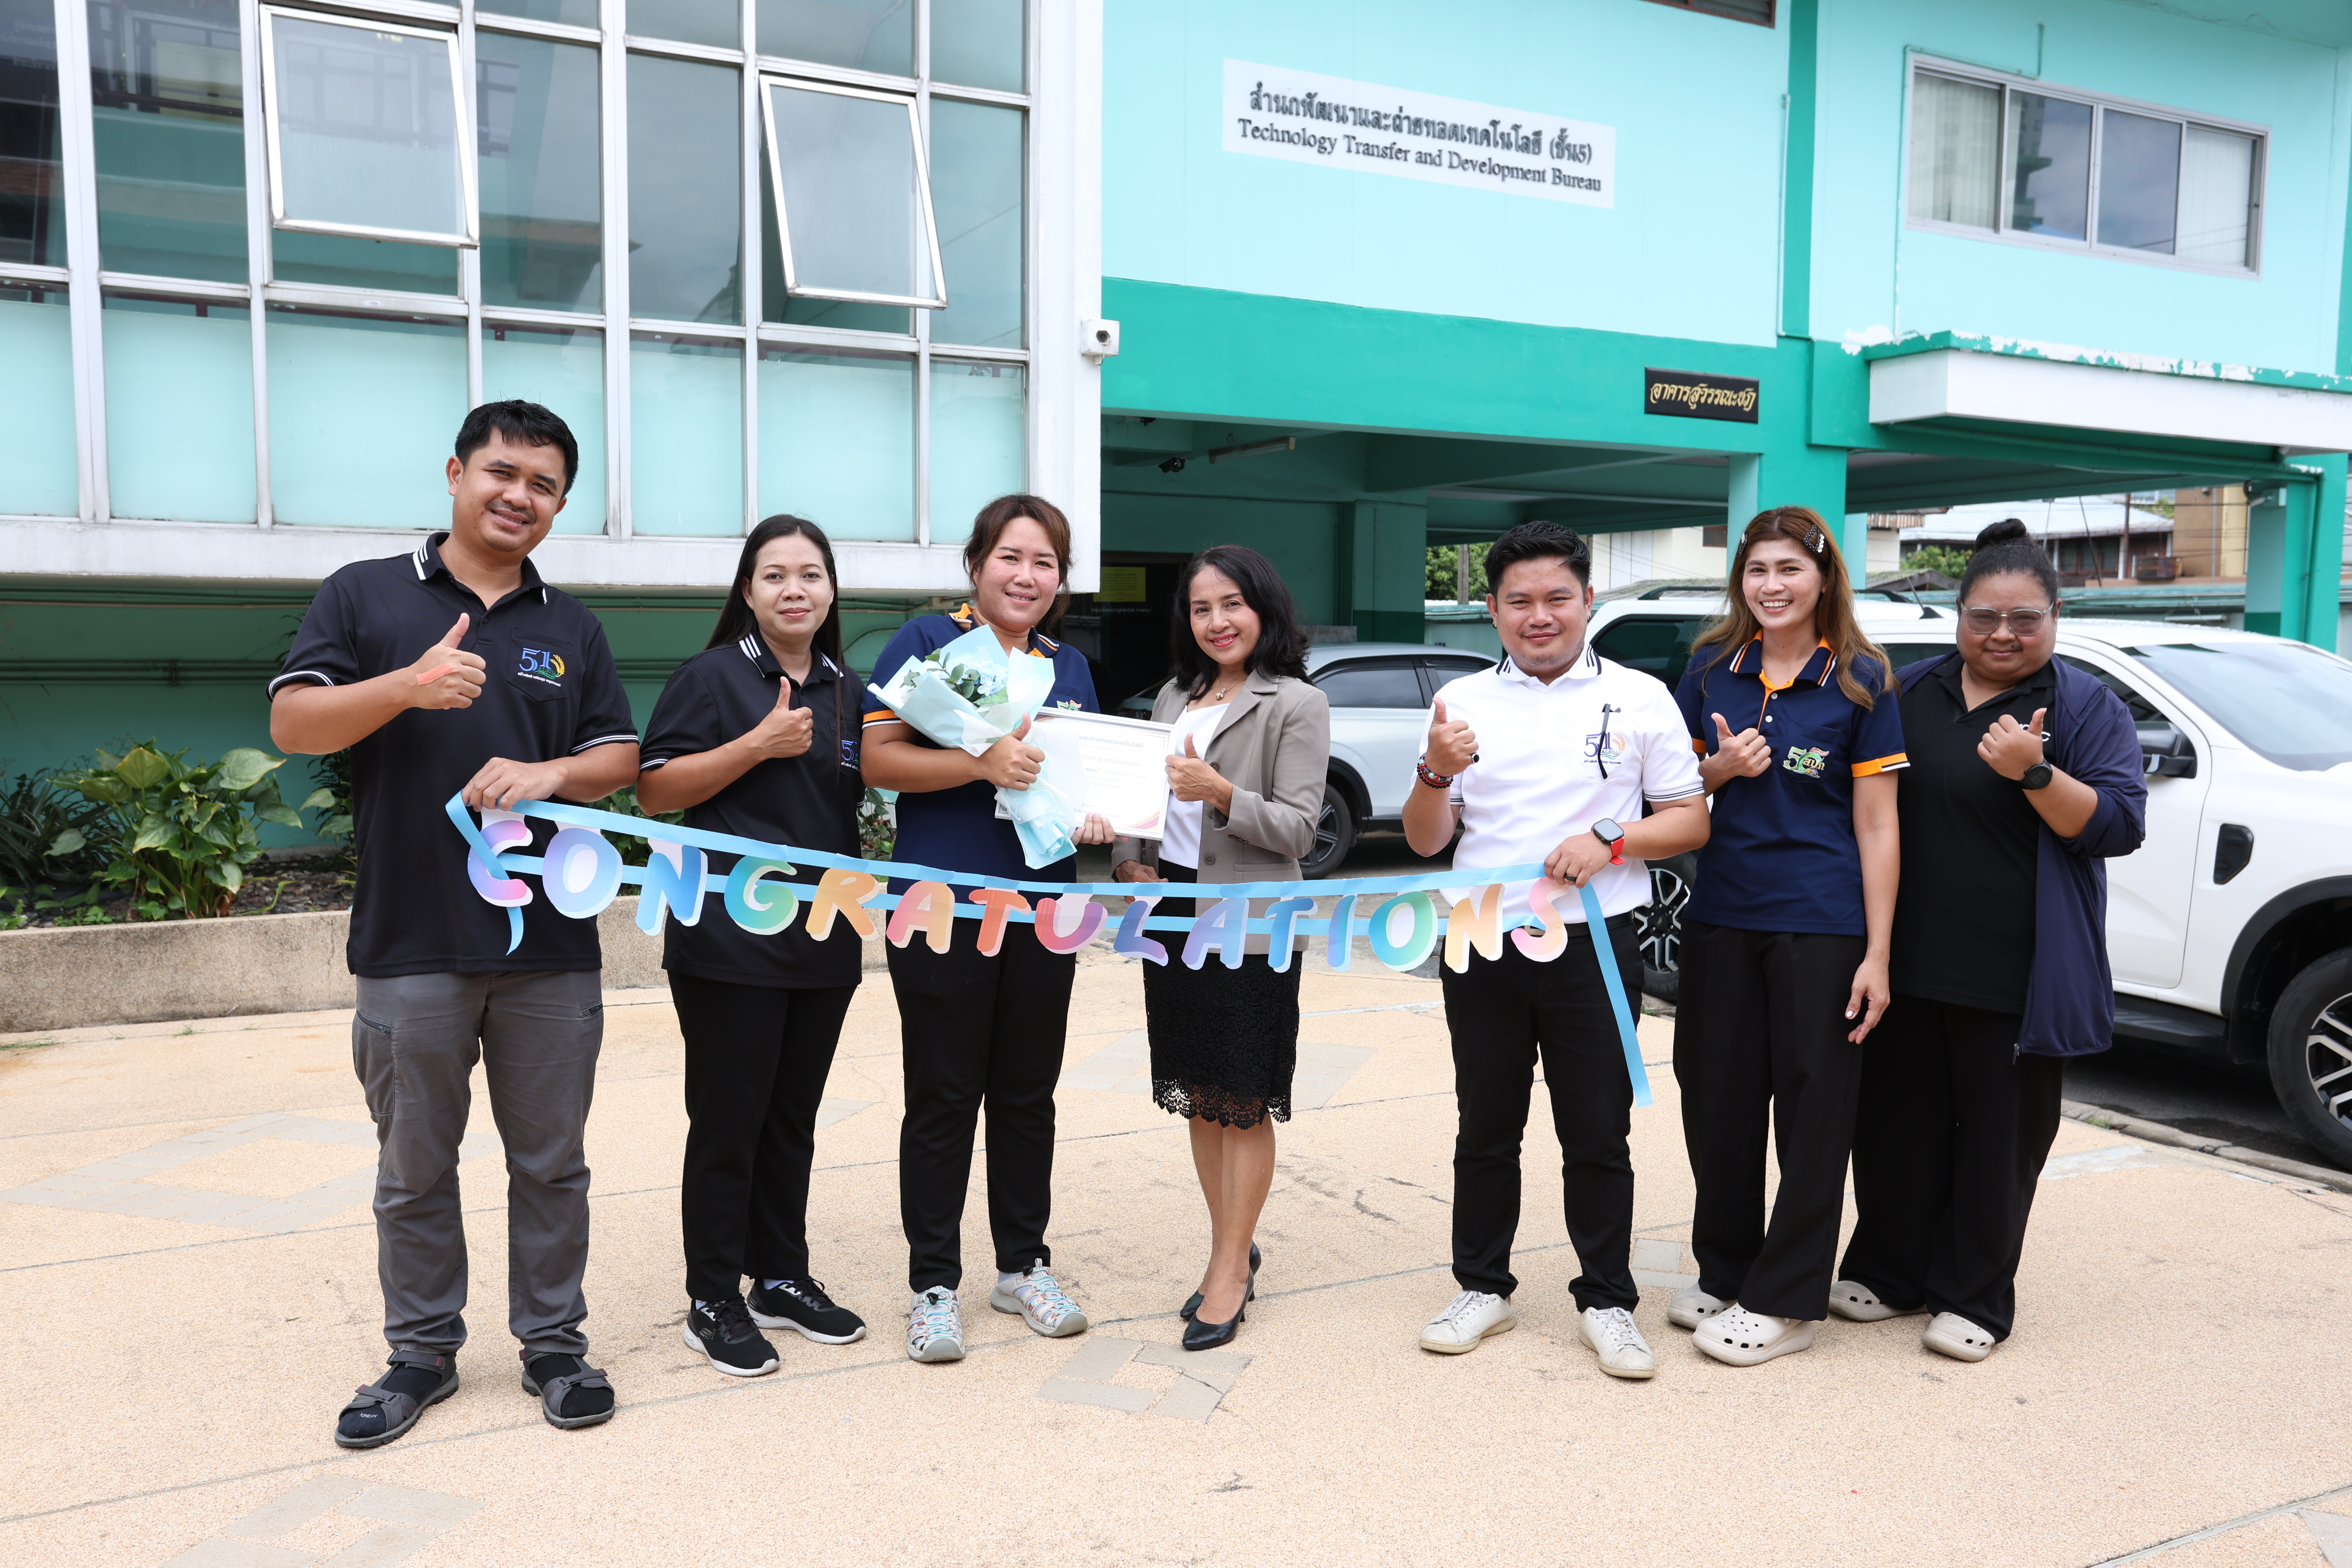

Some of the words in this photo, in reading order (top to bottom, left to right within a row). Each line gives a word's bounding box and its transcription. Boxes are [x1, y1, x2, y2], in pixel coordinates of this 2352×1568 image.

[1237, 117, 1337, 155] Technology
[1343, 134, 1410, 162] Transfer
[1415, 149, 1442, 167] and
[1448, 151, 1546, 182] Development
[1551, 167, 1601, 191] Bureau
[1549, 128, 1593, 165] (ชั้น5)
[519, 648, 551, 671] 51
[467, 818, 1568, 974] CONGRATULATIONS
